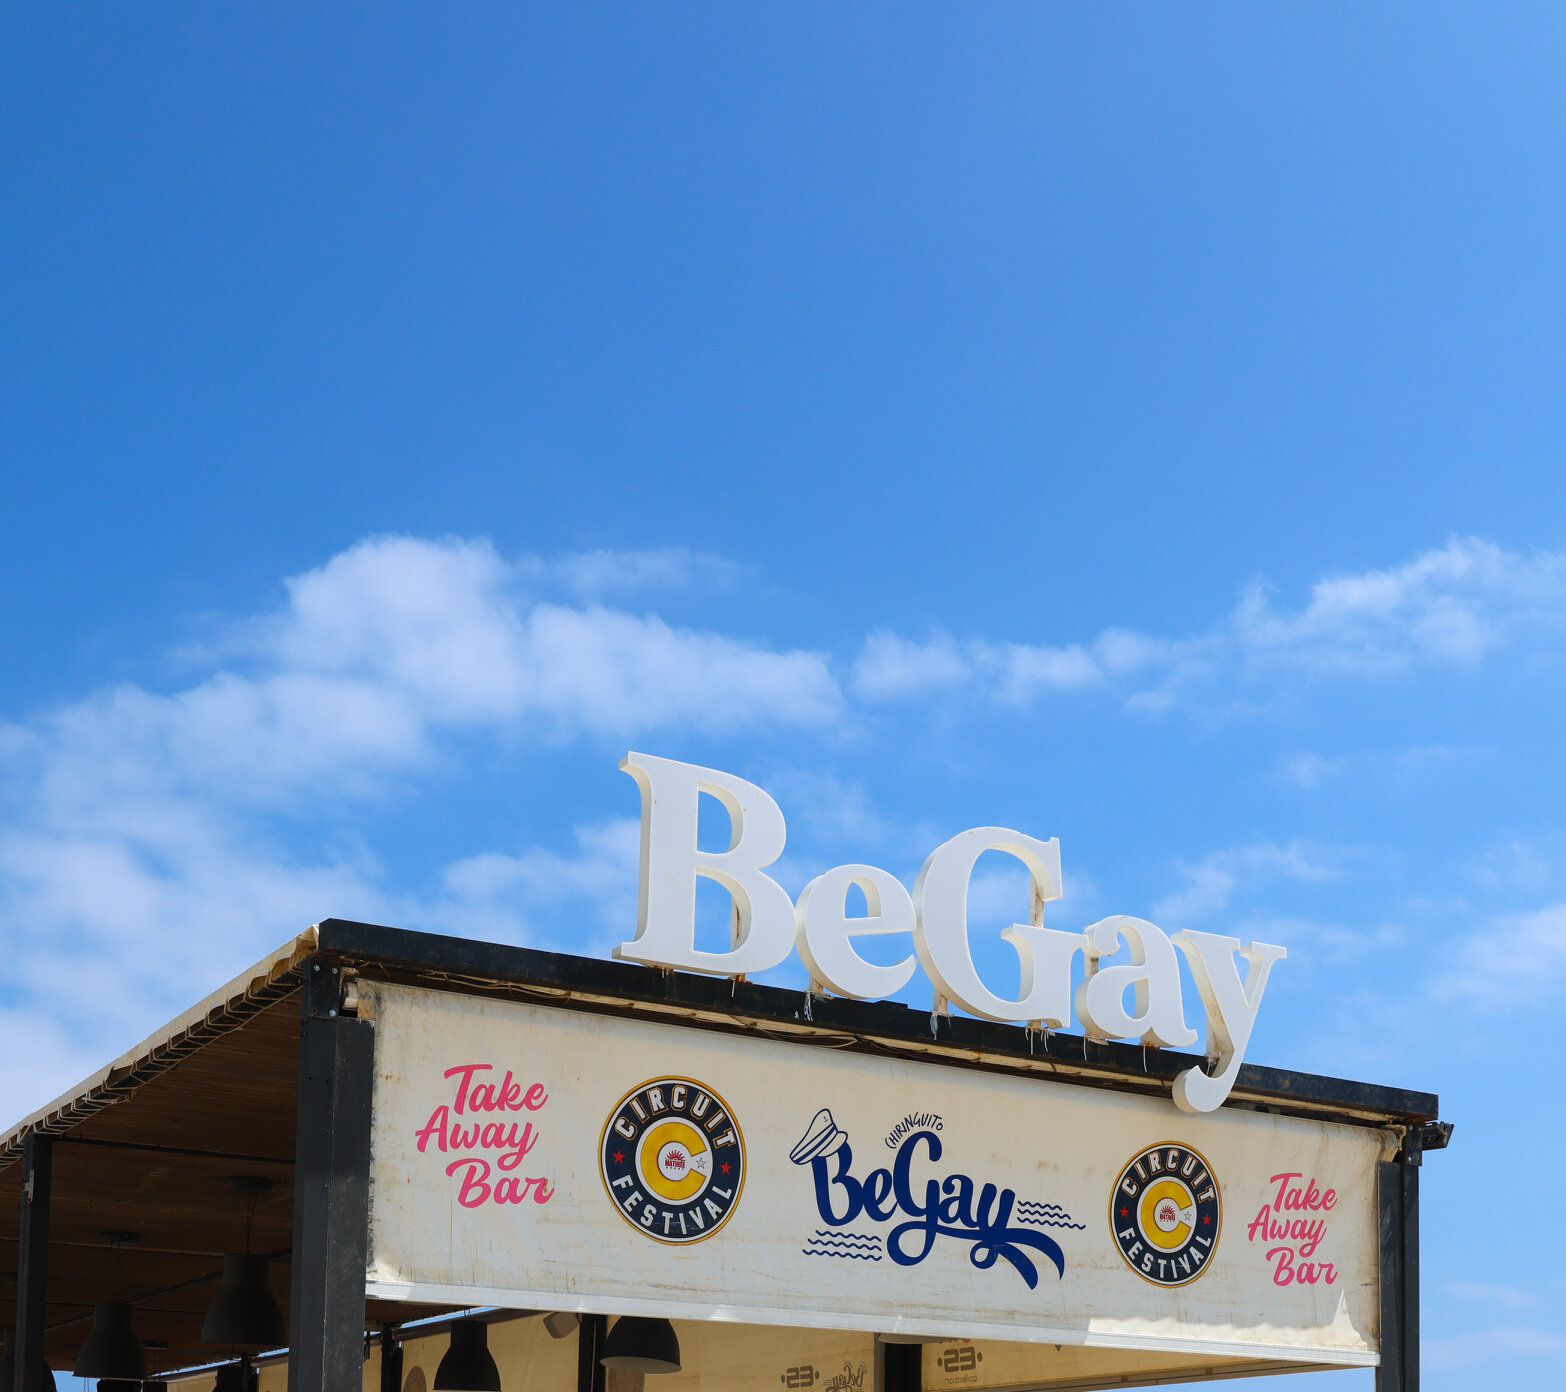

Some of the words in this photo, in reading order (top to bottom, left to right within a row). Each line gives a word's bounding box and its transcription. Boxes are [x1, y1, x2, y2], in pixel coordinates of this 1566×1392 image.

[612, 751, 1286, 1112] BeGay
[443, 1063, 549, 1115] Take
[415, 1104, 539, 1171] Away
[614, 1084, 736, 1150] CIRCUIT
[885, 1112, 943, 1149] CHIRINGUITO
[445, 1158, 554, 1208] Bar
[1121, 1148, 1216, 1204] CIRCUIT
[1269, 1172, 1338, 1213] Take
[612, 1173, 733, 1235] FESTIVAL
[811, 1131, 1065, 1290] BeGay
[1247, 1204, 1328, 1258] Away
[1119, 1227, 1211, 1279] FESTIVAL
[1266, 1246, 1338, 1286] Bar
